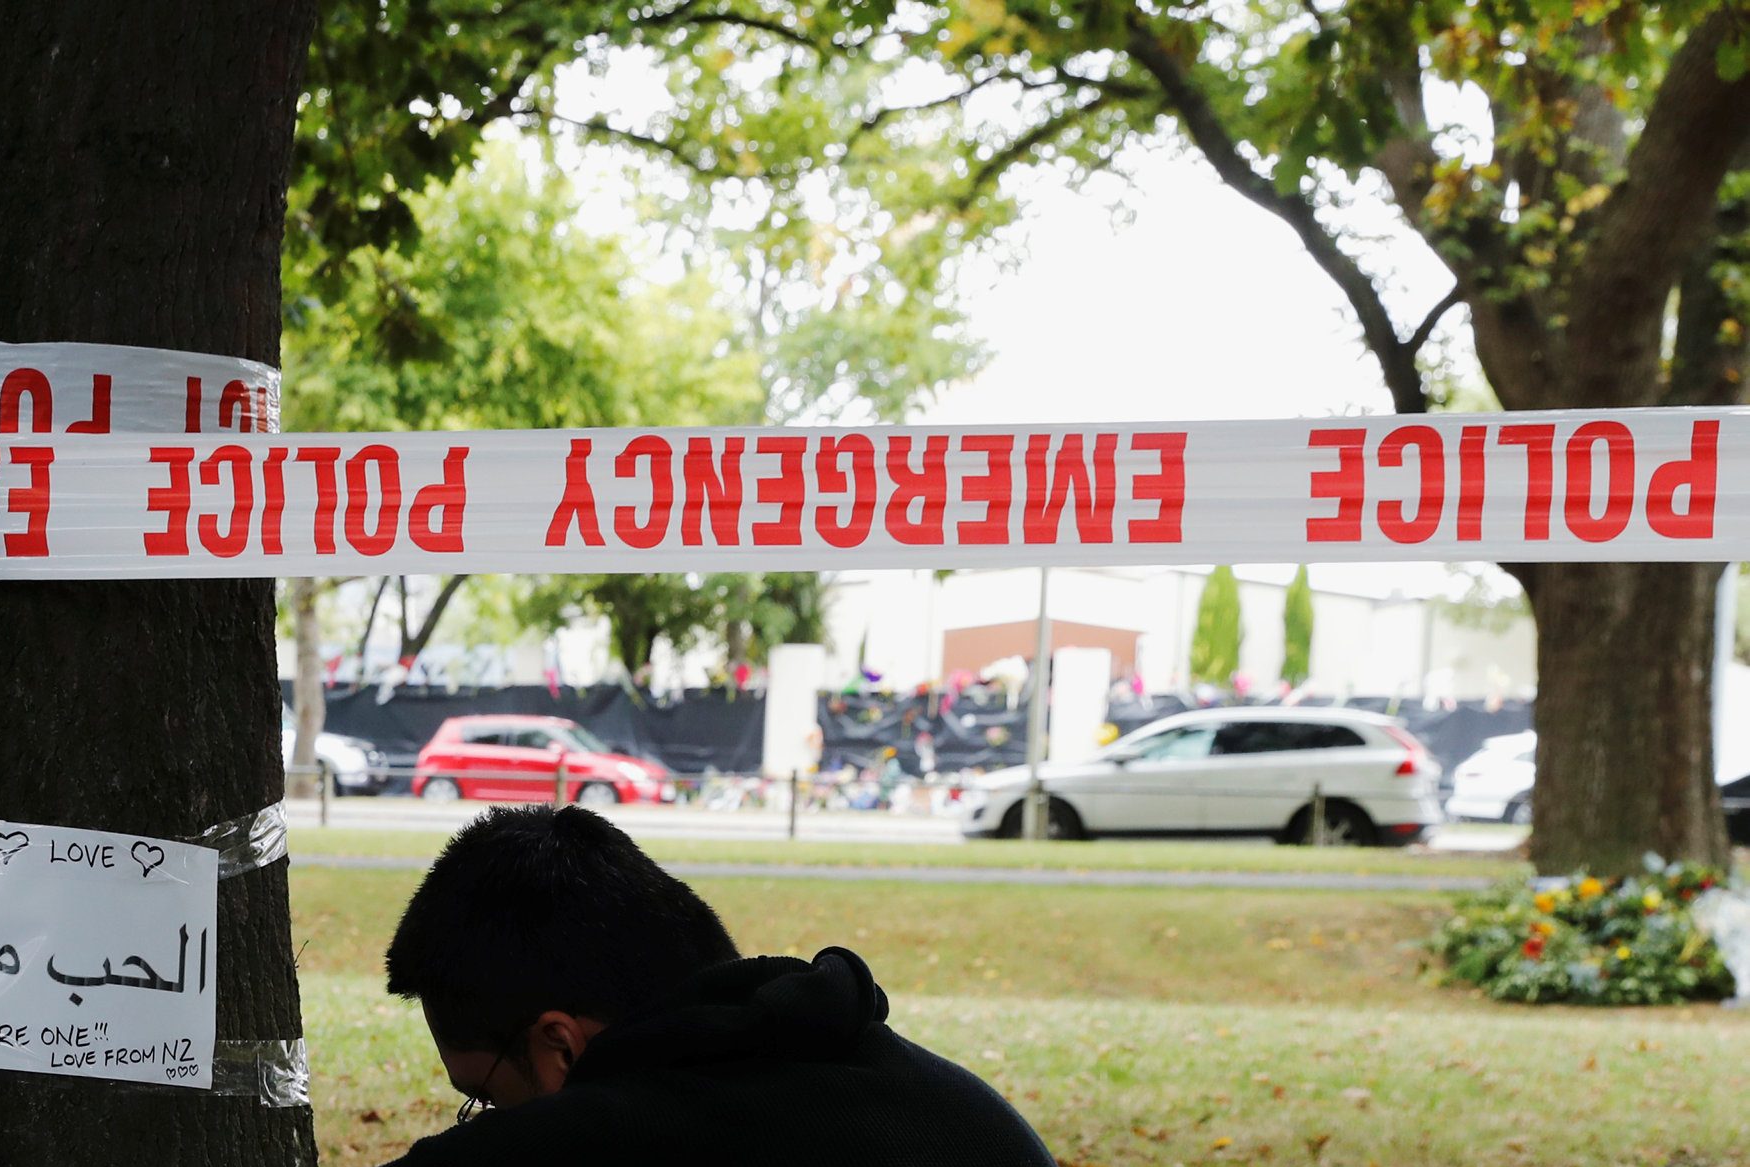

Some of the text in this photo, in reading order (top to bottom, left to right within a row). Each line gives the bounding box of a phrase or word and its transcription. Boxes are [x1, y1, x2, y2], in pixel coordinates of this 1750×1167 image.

[143, 444, 470, 559] POLICE
[545, 431, 1187, 549] EMERGENCY
[1306, 419, 1720, 545] POLICE
[50, 839, 115, 869] LOVE
[46, 923, 207, 1007] الحب
[40, 1022, 110, 1048] ONE!!!
[50, 1038, 196, 1069] LOVE FROM NZ
